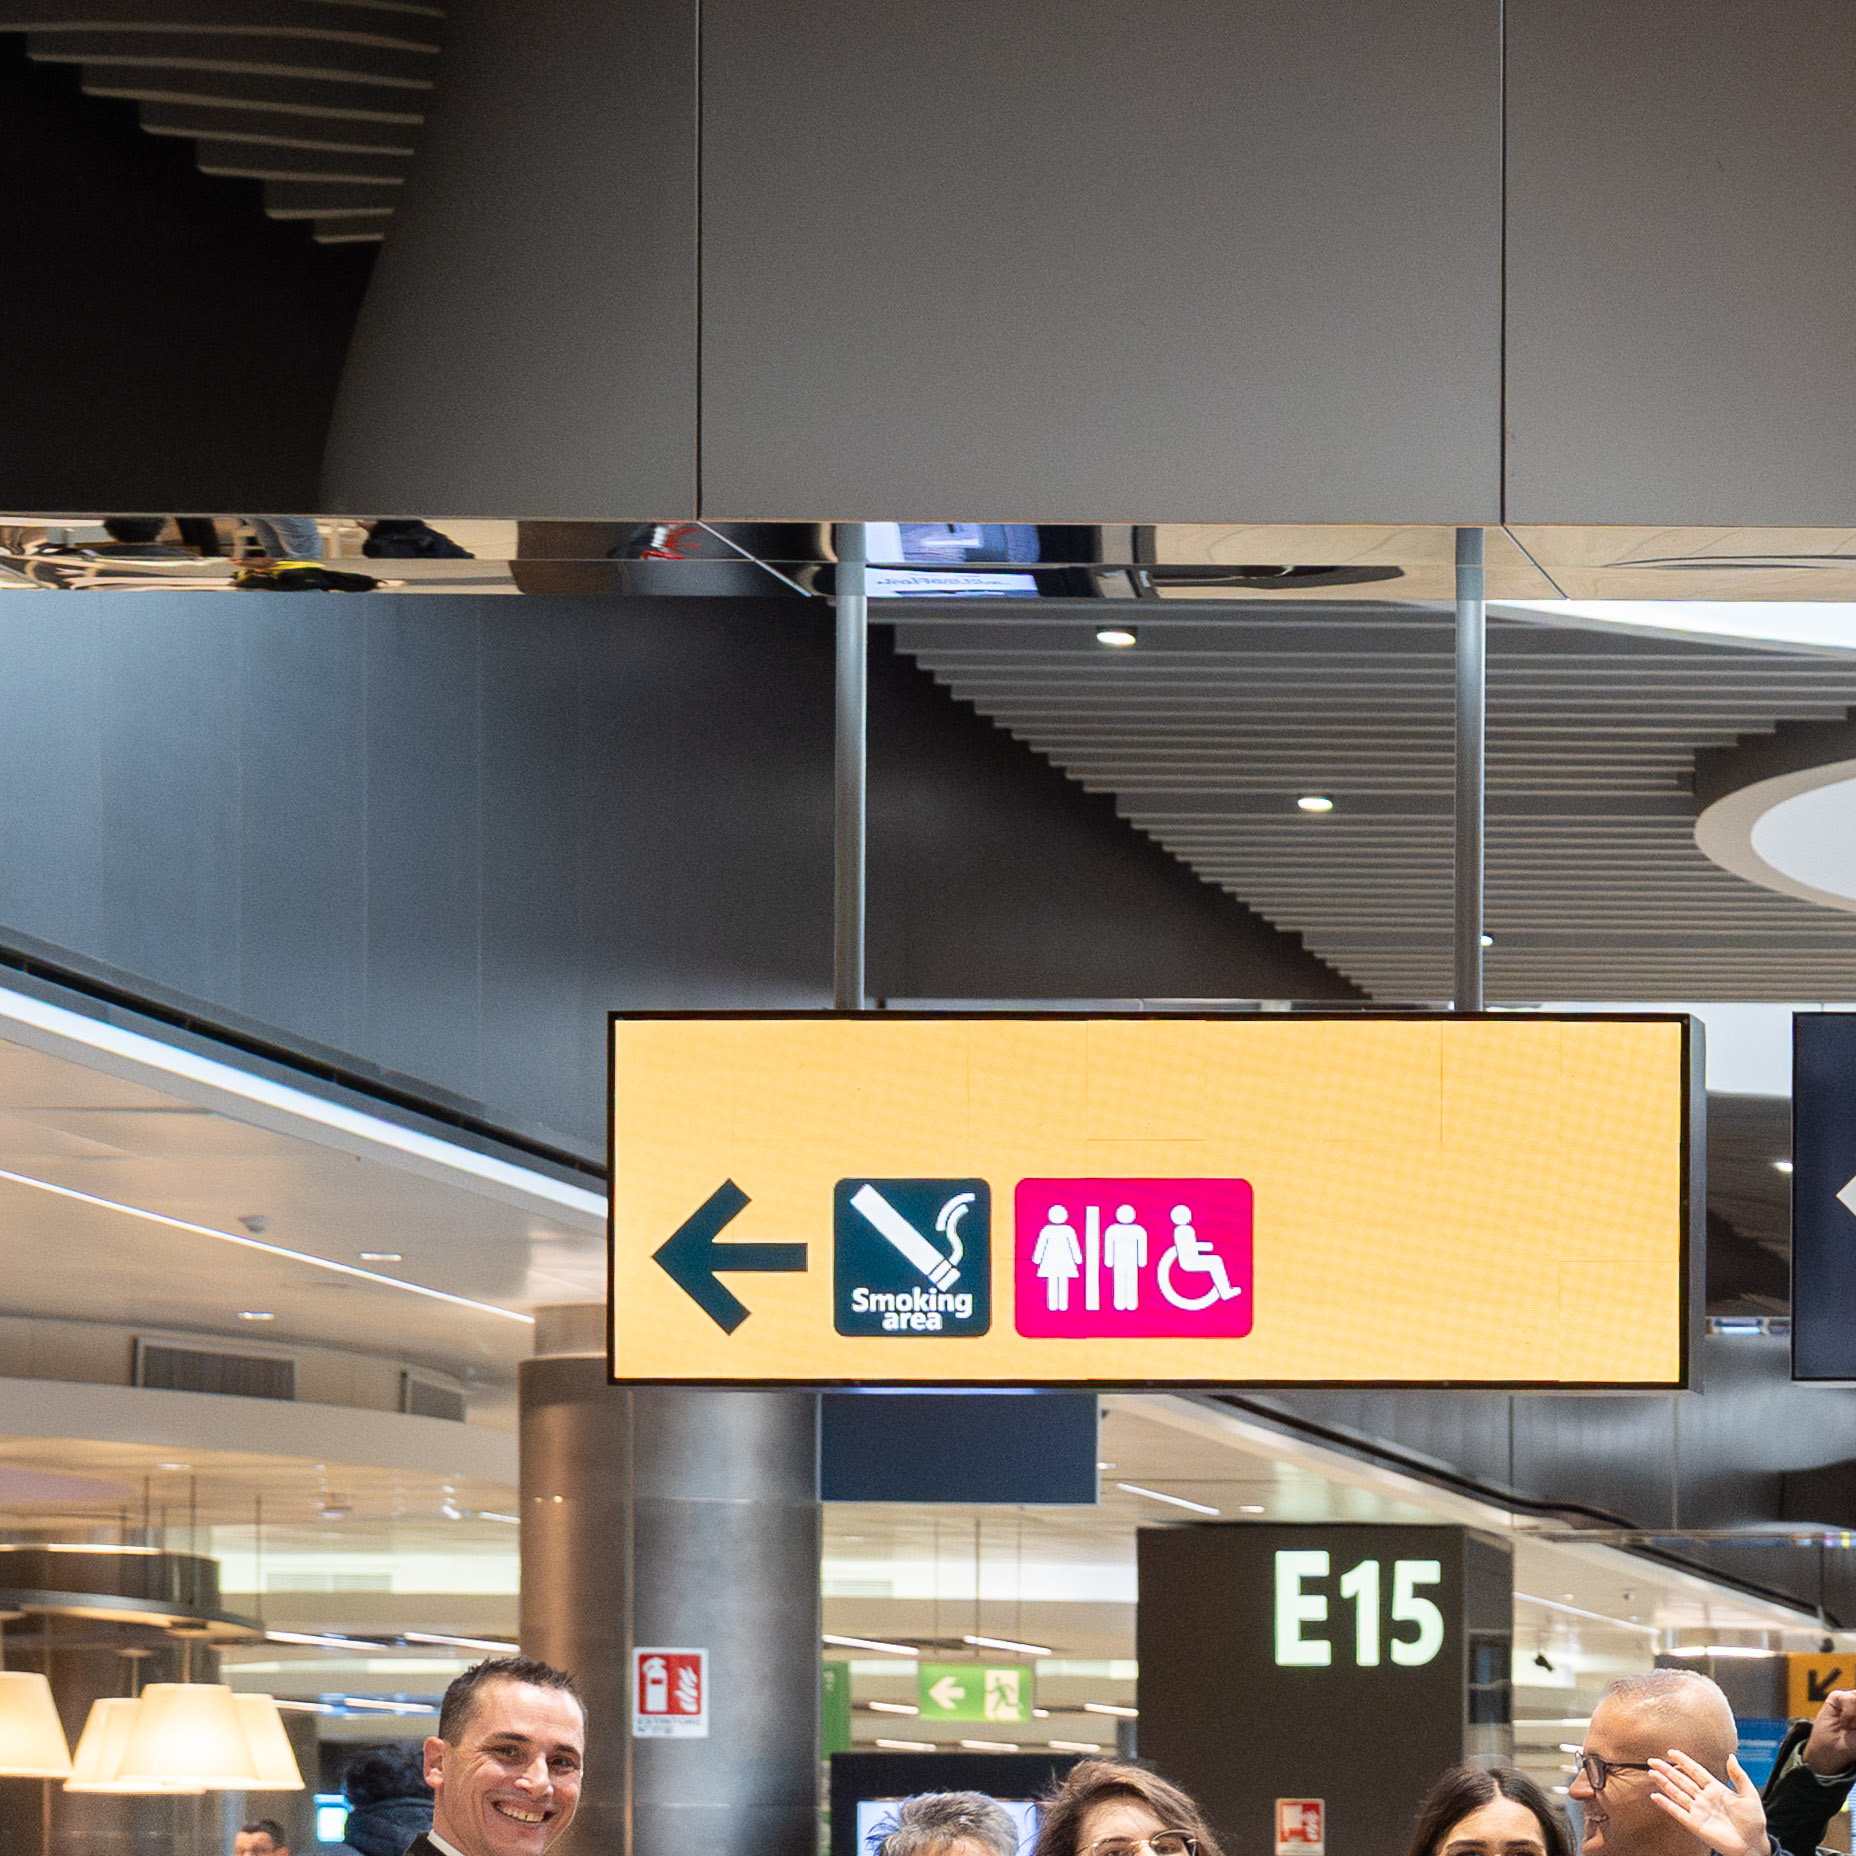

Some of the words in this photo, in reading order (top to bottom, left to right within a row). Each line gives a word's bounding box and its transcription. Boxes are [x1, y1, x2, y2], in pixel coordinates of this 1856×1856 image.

[851, 1286, 973, 1319] Smoking
[882, 1308, 943, 1331] area
[1275, 1551, 1443, 1666] E15
